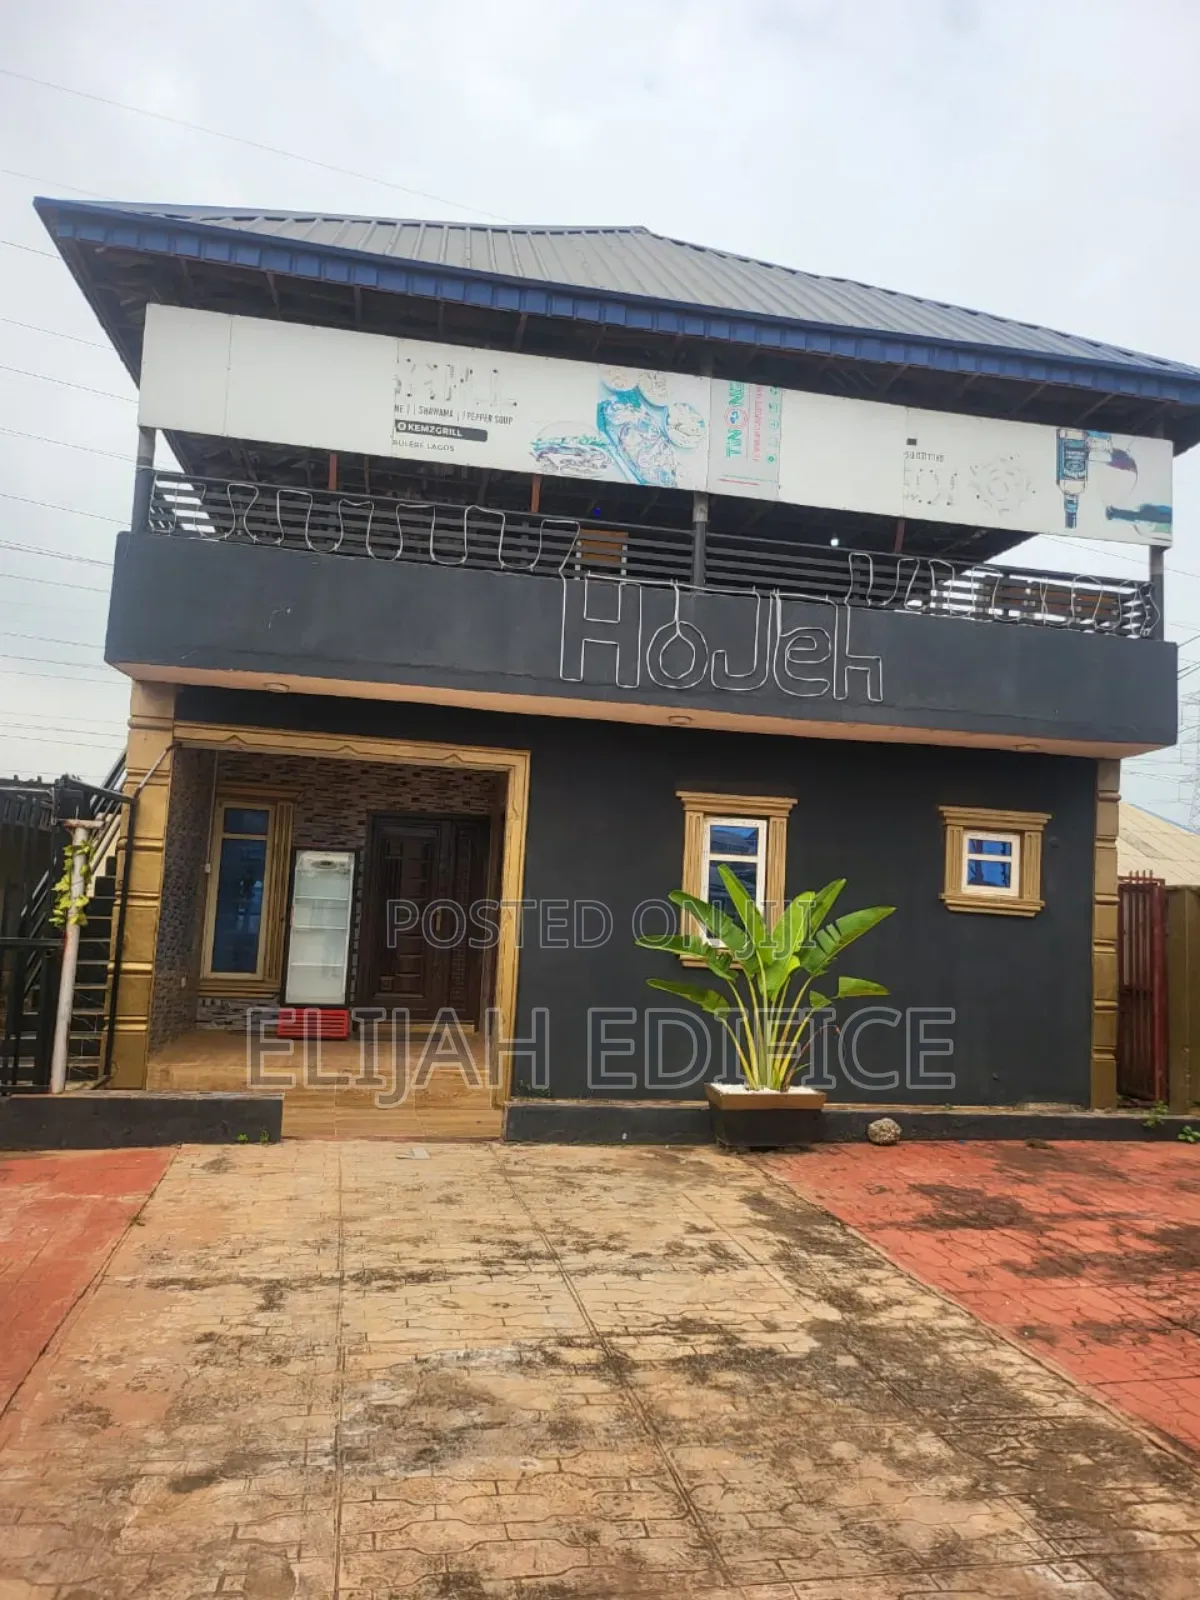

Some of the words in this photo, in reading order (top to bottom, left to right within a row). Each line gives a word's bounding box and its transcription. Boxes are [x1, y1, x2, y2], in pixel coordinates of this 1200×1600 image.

[467, 411, 493, 423] PEPPER
[494, 414, 513, 426] SOUP
[408, 423, 463, 437] KEMZGRILL
[426, 443, 455, 452] LAGOS
